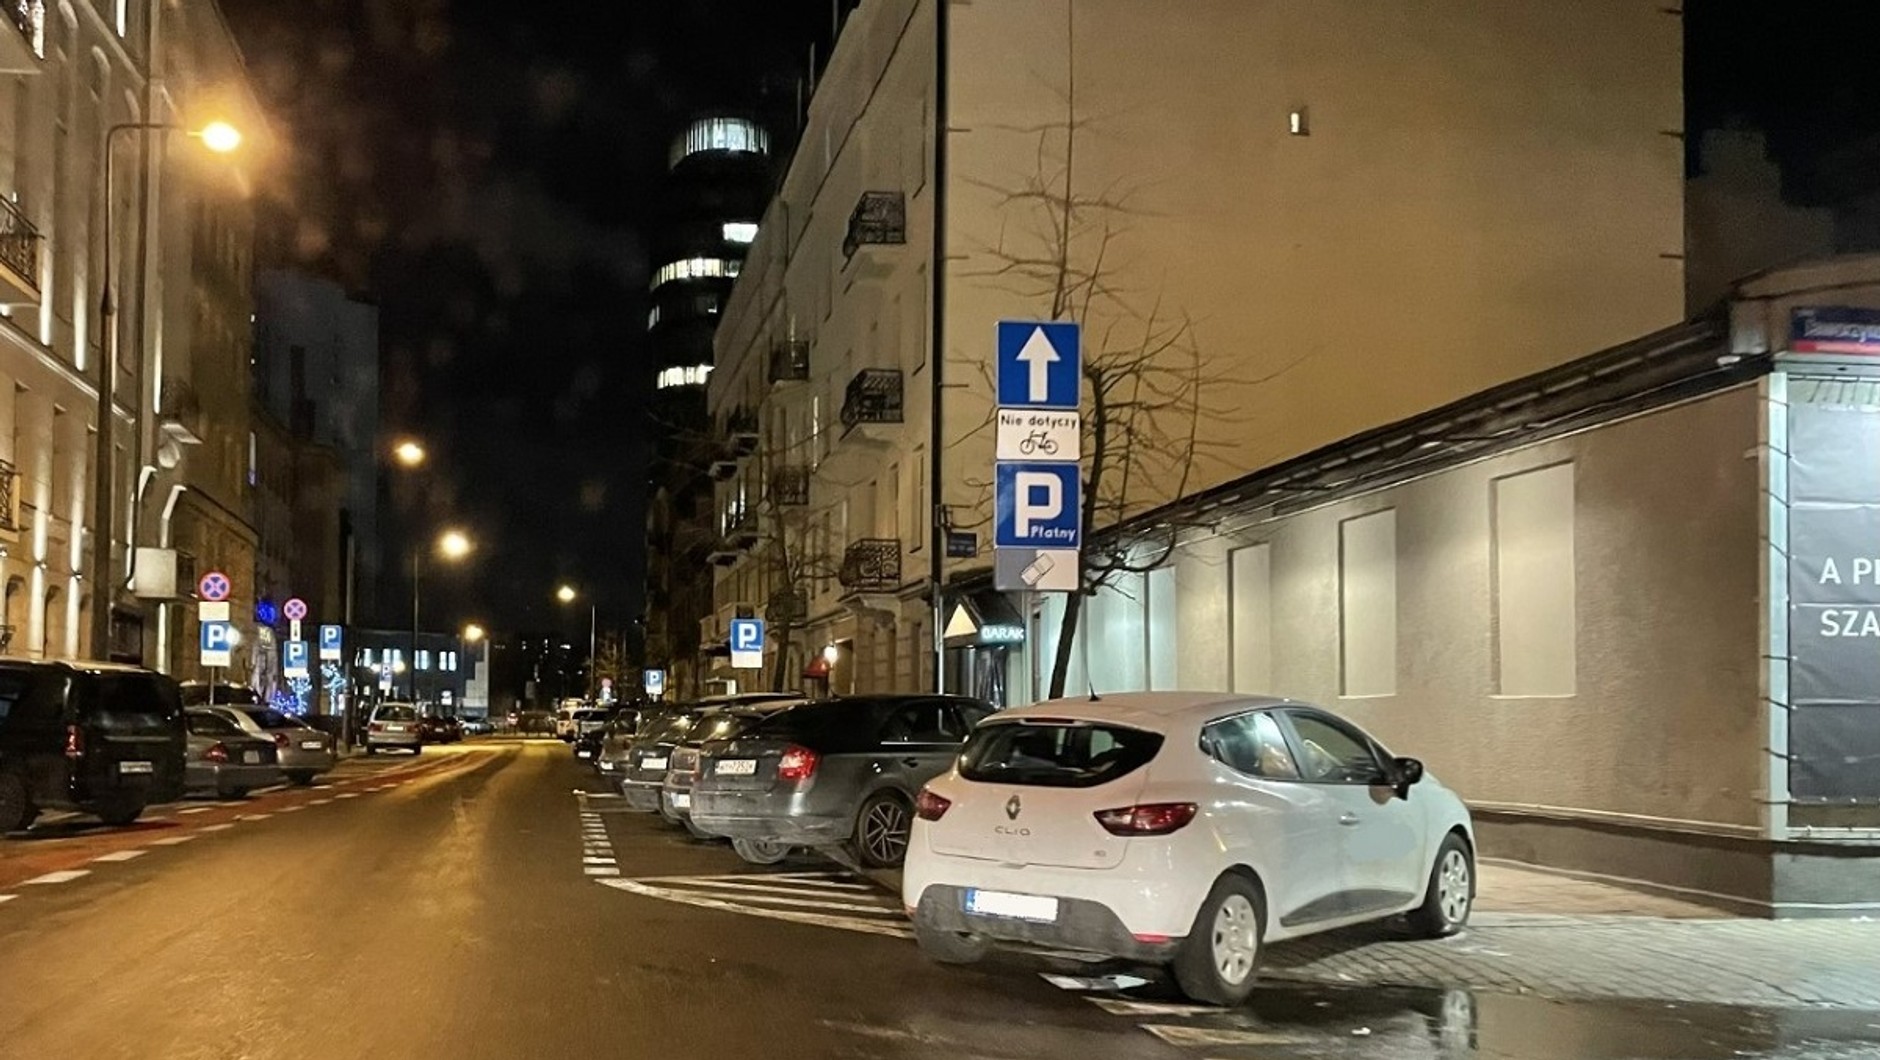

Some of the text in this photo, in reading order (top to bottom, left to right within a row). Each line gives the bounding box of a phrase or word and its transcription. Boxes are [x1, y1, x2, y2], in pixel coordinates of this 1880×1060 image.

[1001, 414, 1077, 429] Nie dotyczy
[1015, 471, 1063, 538] P
[1819, 557, 1842, 585] A
[1820, 609, 1880, 637] SZA
[207, 624, 226, 649] P
[324, 627, 338, 643] P
[738, 623, 757, 649] P
[289, 643, 304, 661] P
[649, 671, 660, 685] P
[994, 825, 1031, 837] CLIO
